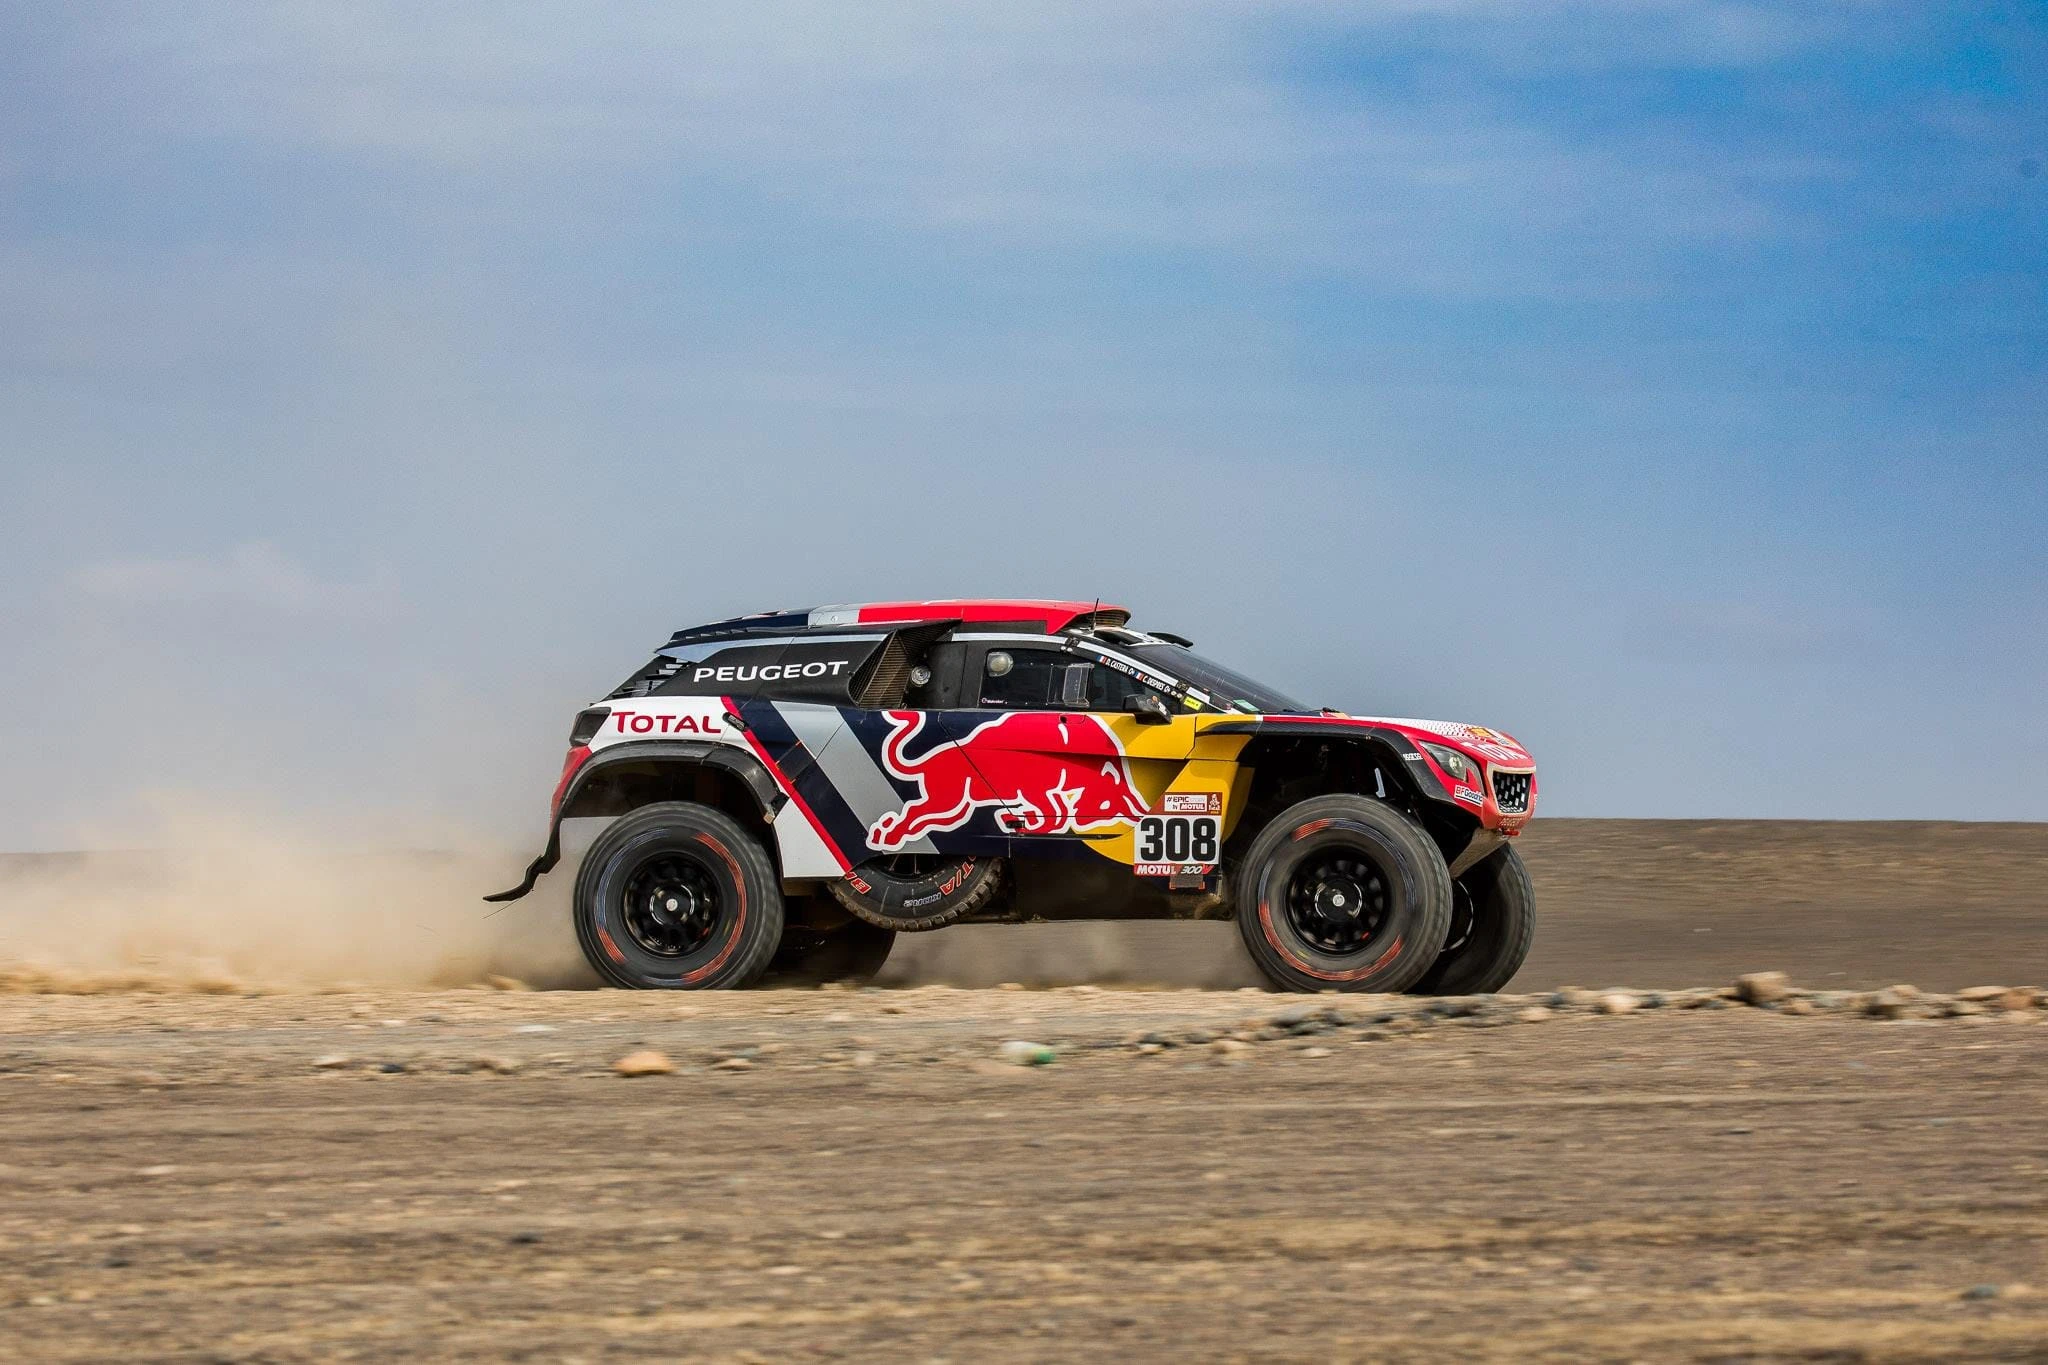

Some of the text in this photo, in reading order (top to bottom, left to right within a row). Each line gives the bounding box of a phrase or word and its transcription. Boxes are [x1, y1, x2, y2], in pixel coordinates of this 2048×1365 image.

[693, 661, 849, 683] PEUGEOT
[612, 711, 722, 734] TOTAL
[1141, 818, 1216, 861] 308
[1136, 865, 1214, 875] MOTUL 300V
